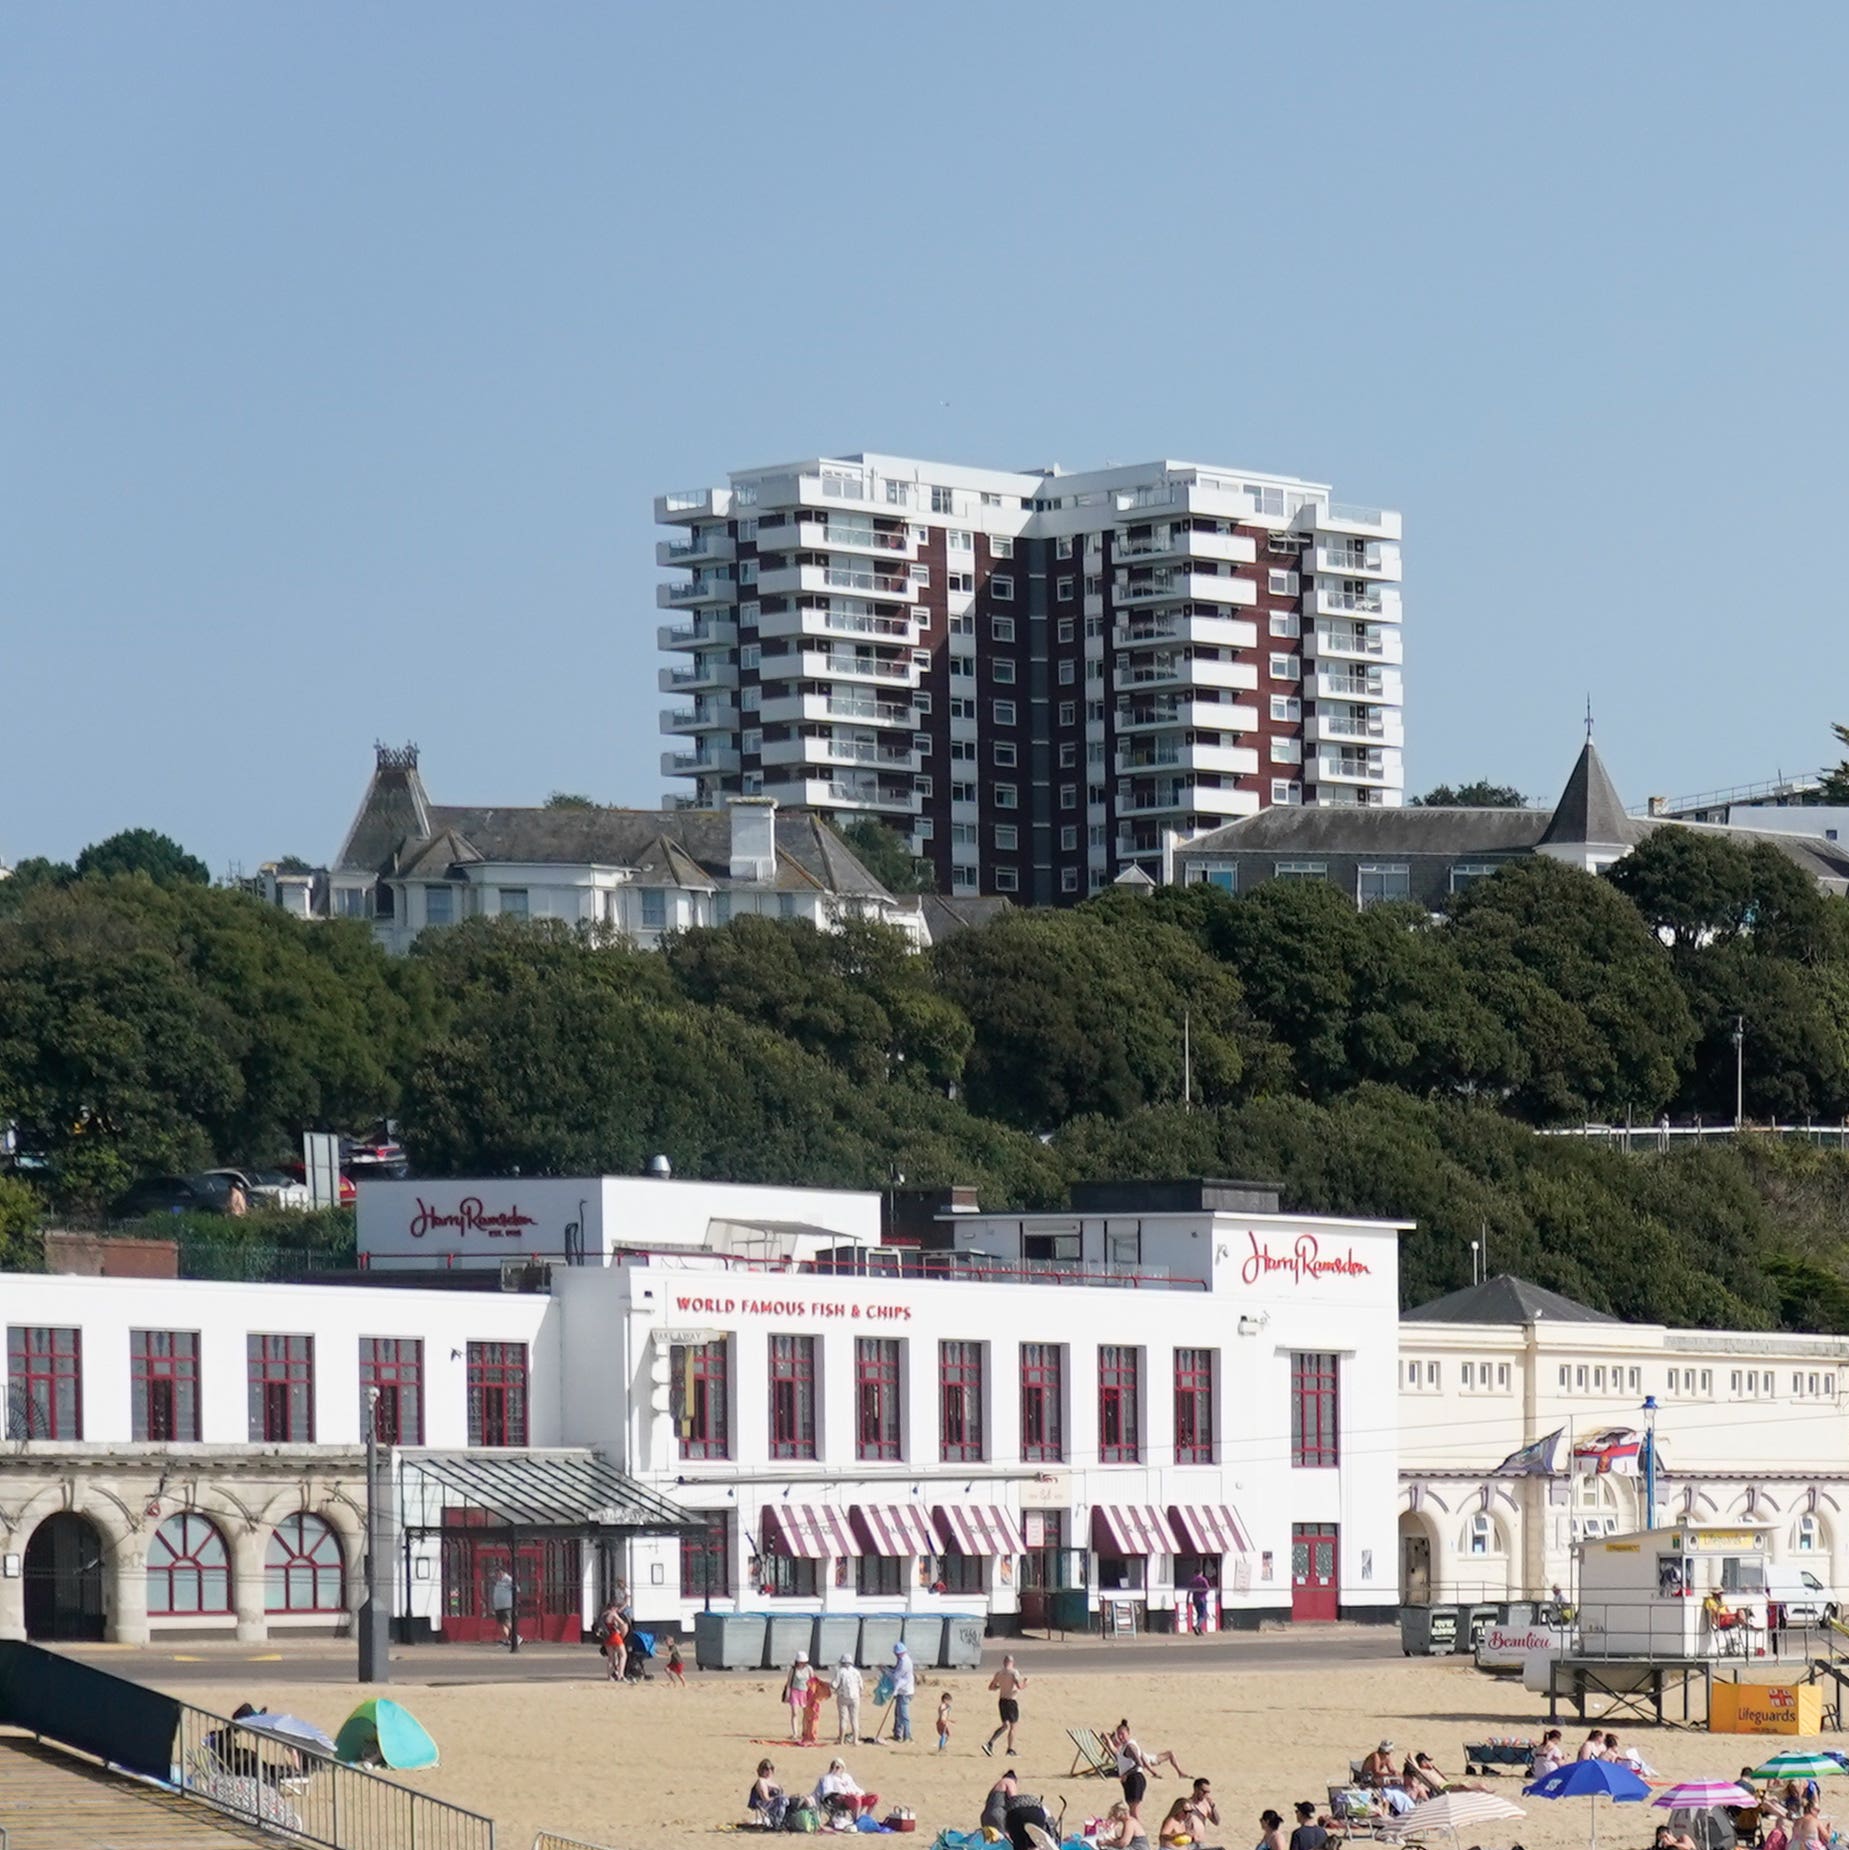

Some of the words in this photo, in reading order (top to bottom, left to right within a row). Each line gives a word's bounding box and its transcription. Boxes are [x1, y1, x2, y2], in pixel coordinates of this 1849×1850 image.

[410, 1198, 465, 1238] Harry
[460, 1197, 539, 1231] Ramsden
[1242, 1231, 1299, 1285] Harry
[1295, 1234, 1371, 1280] Ramsden
[676, 1297, 735, 1314] WORLD
[741, 1299, 805, 1317] FAMOUS
[812, 1302, 845, 1318] FISH
[851, 1303, 860, 1319] &
[866, 1304, 912, 1321] CHIPS
[1488, 1631, 1551, 1650] Beaulieu
[1738, 1707, 1796, 1726] Lifeguards
